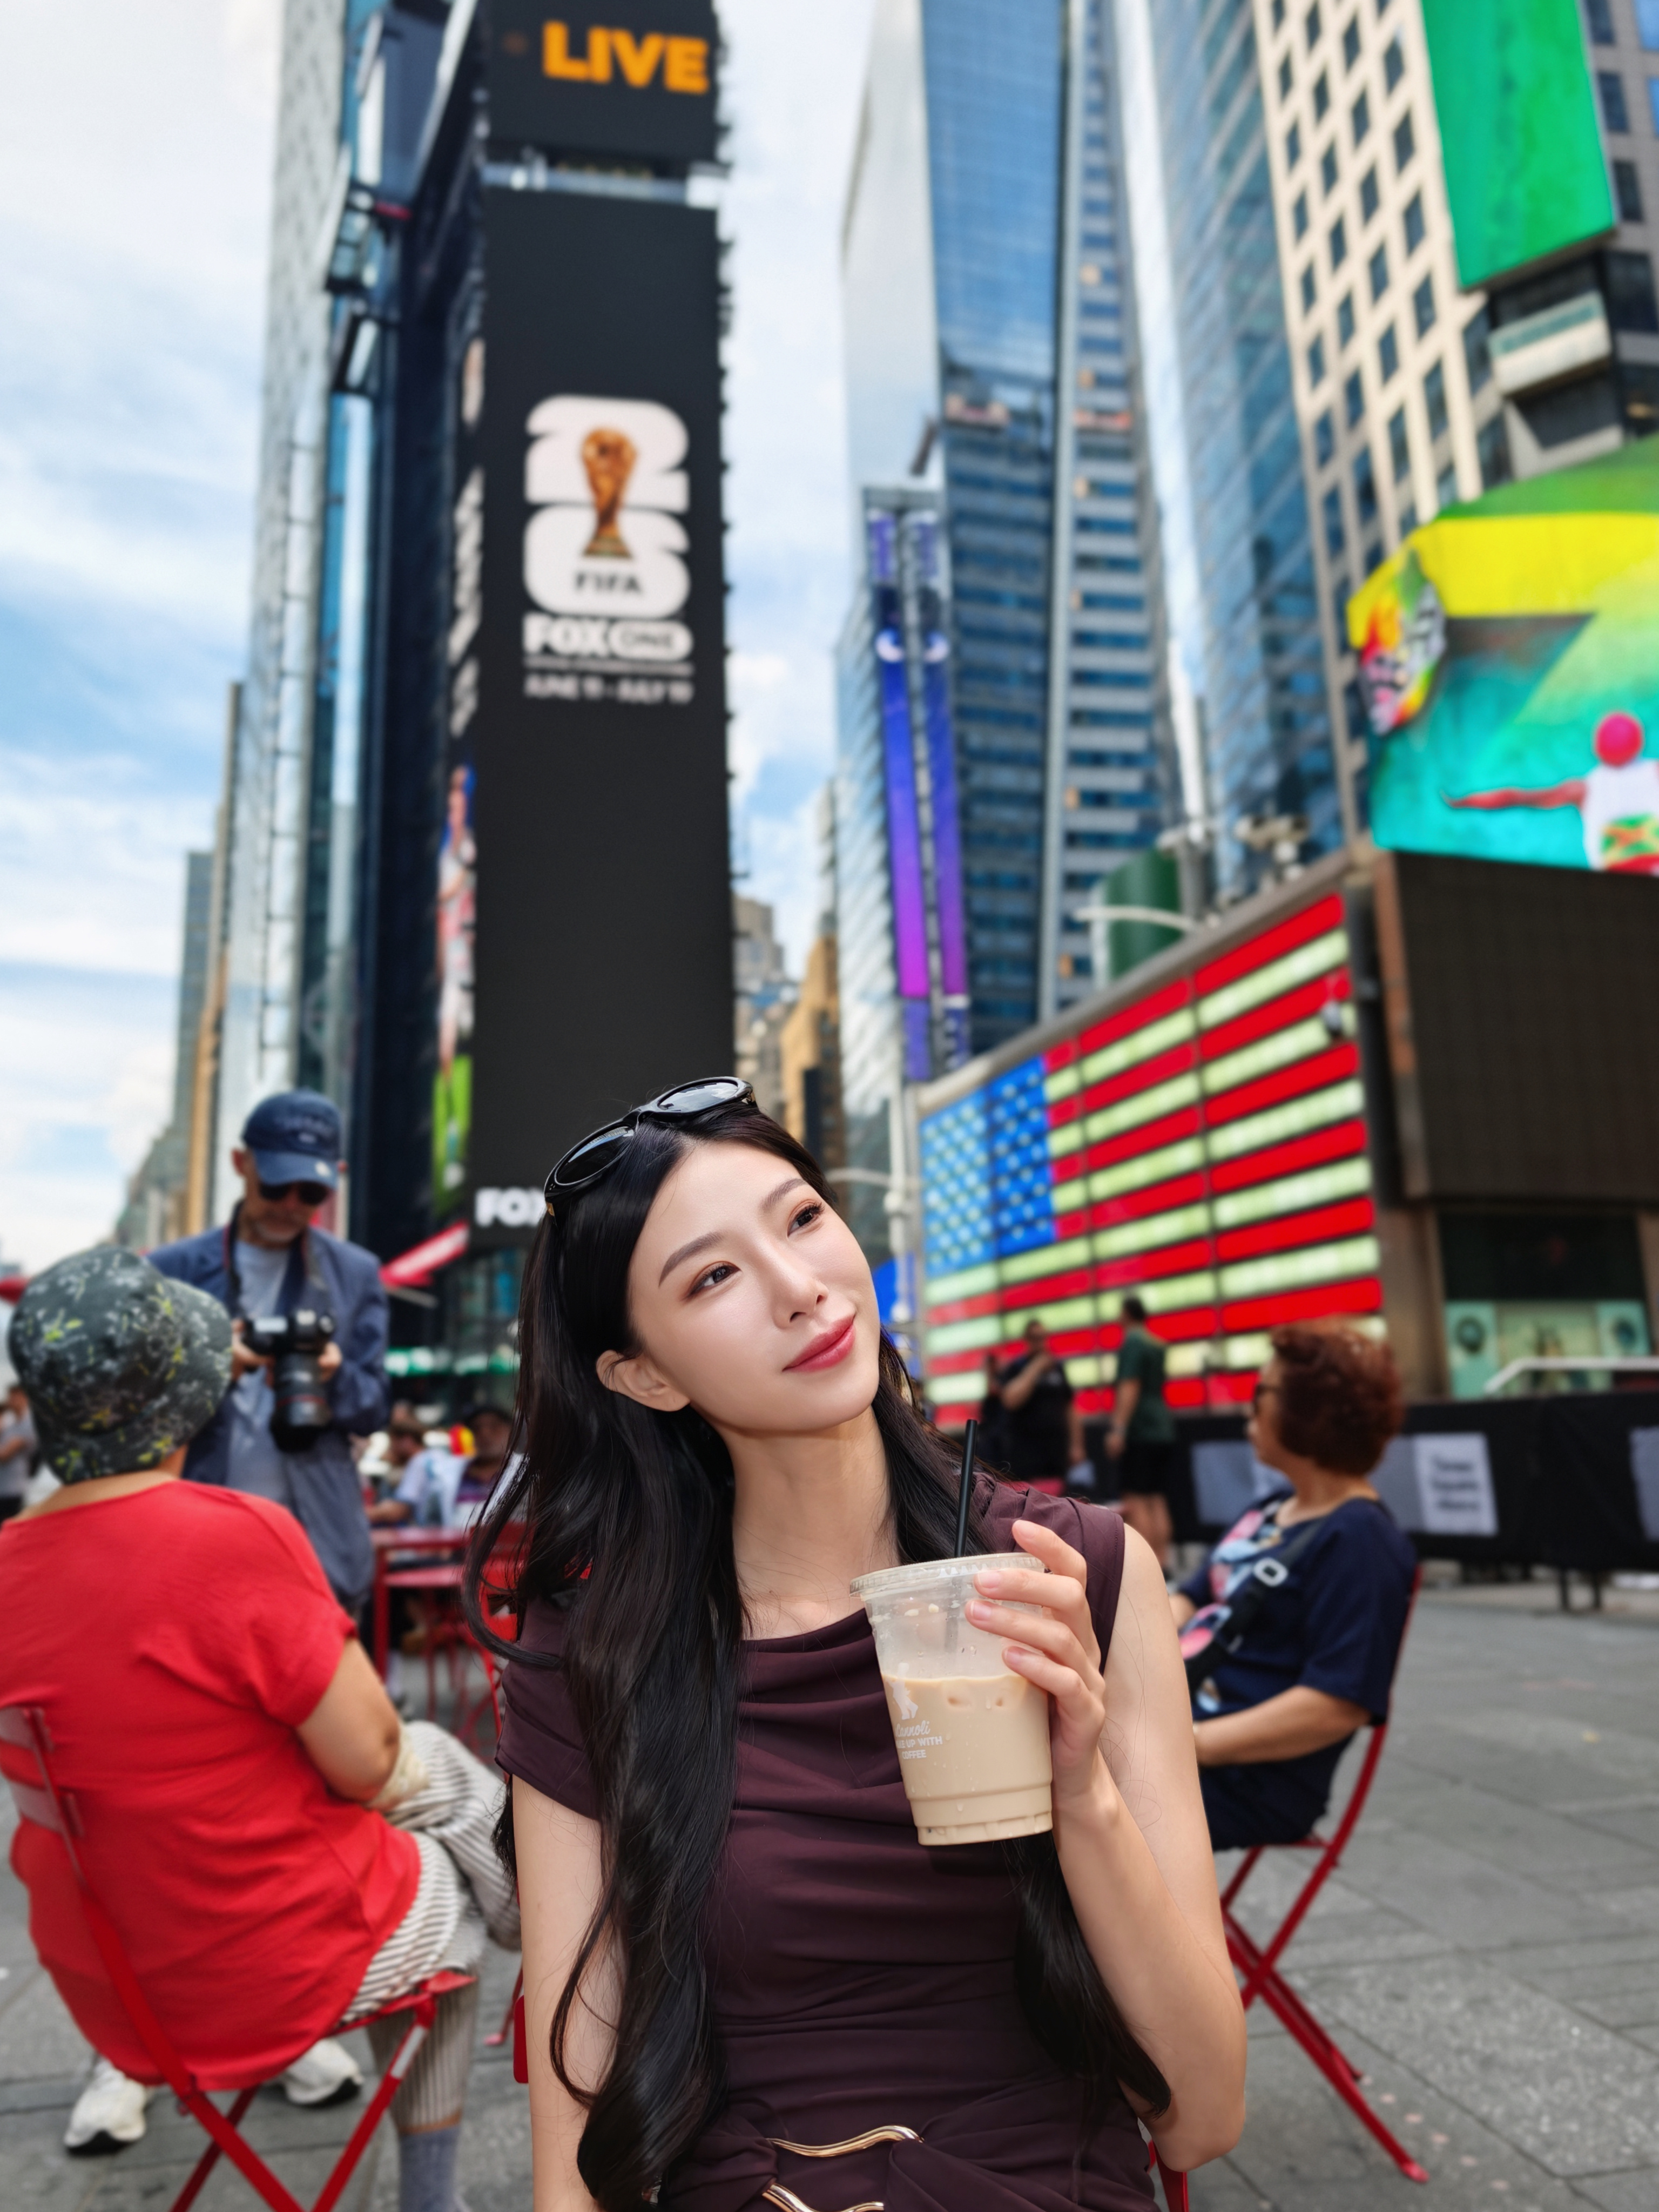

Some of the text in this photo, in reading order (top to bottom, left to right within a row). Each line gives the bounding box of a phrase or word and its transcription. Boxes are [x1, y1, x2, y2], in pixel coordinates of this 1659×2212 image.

[544, 20, 709, 94] LIVE
[575, 572, 643, 593] FIFA
[523, 612, 610, 657] FOX
[906, 1739, 915, 1748] UP
[918, 1736, 943, 1746] WITH
[902, 1749, 927, 1759] COFFEE
